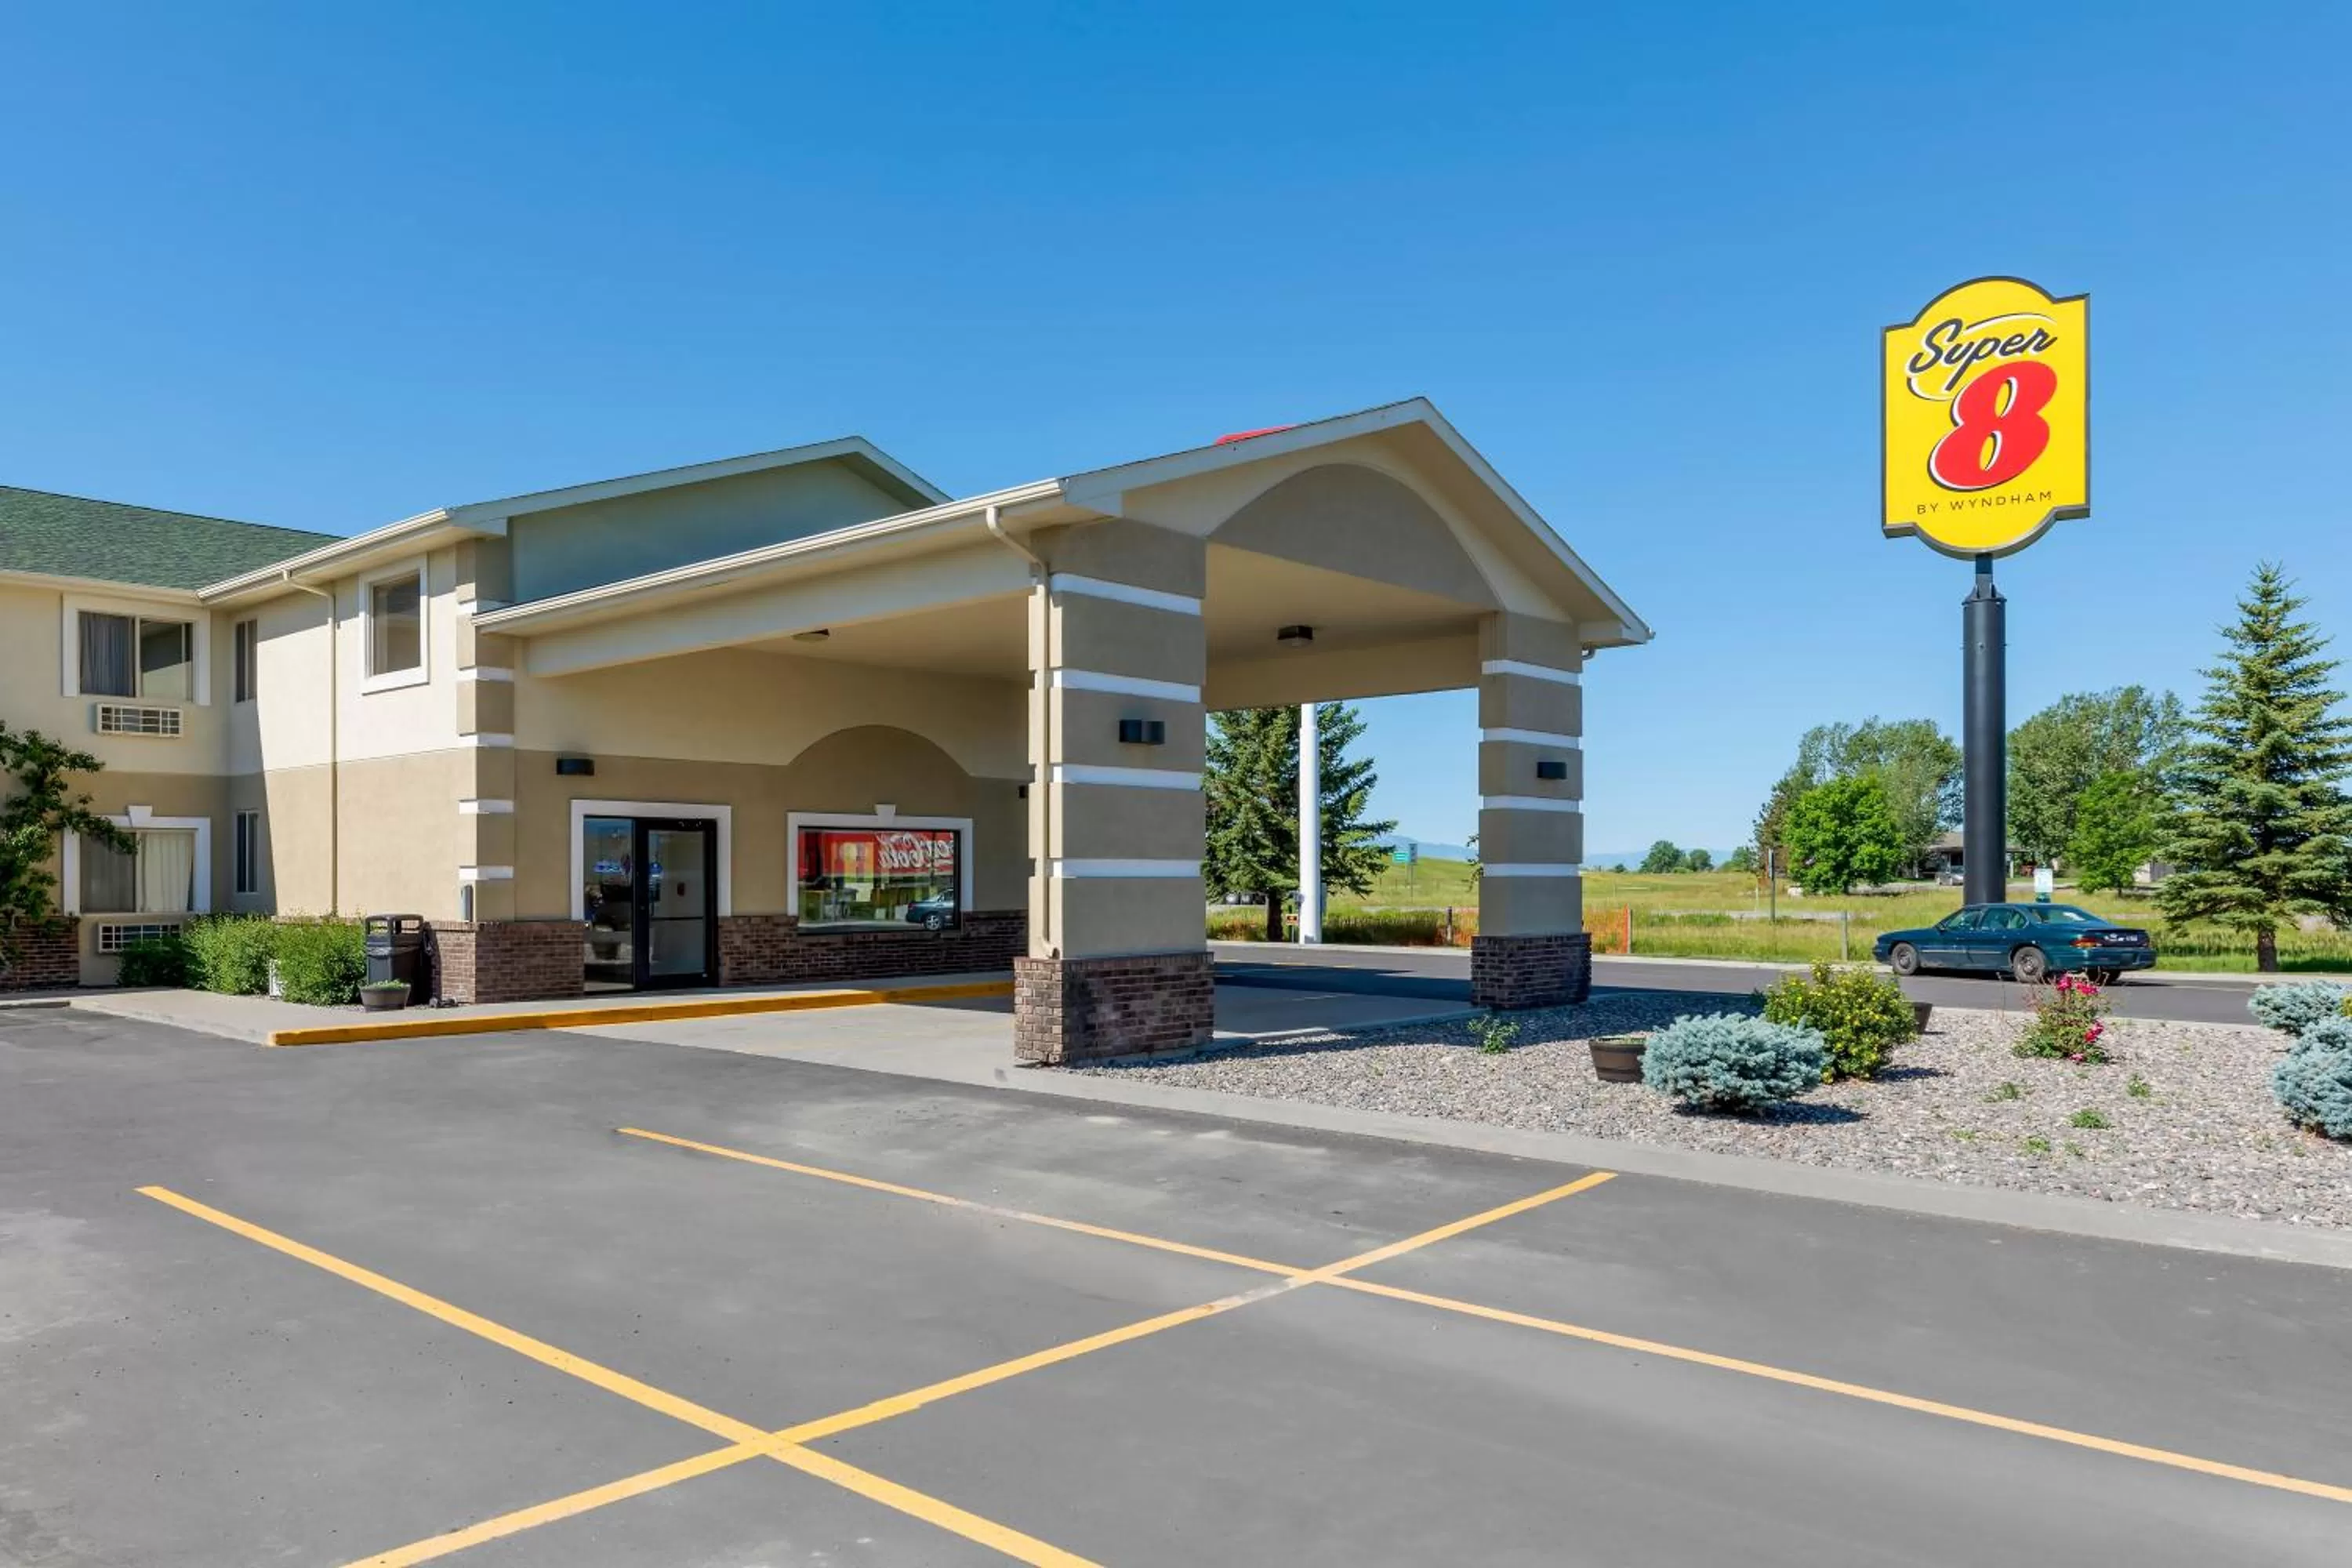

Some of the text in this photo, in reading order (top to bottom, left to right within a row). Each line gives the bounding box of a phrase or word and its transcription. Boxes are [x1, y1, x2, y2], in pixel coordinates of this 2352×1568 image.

[1907, 317, 2059, 392] Super
[1927, 360, 2058, 492] 8
[1916, 490, 2053, 515] BY WYNDHAM
